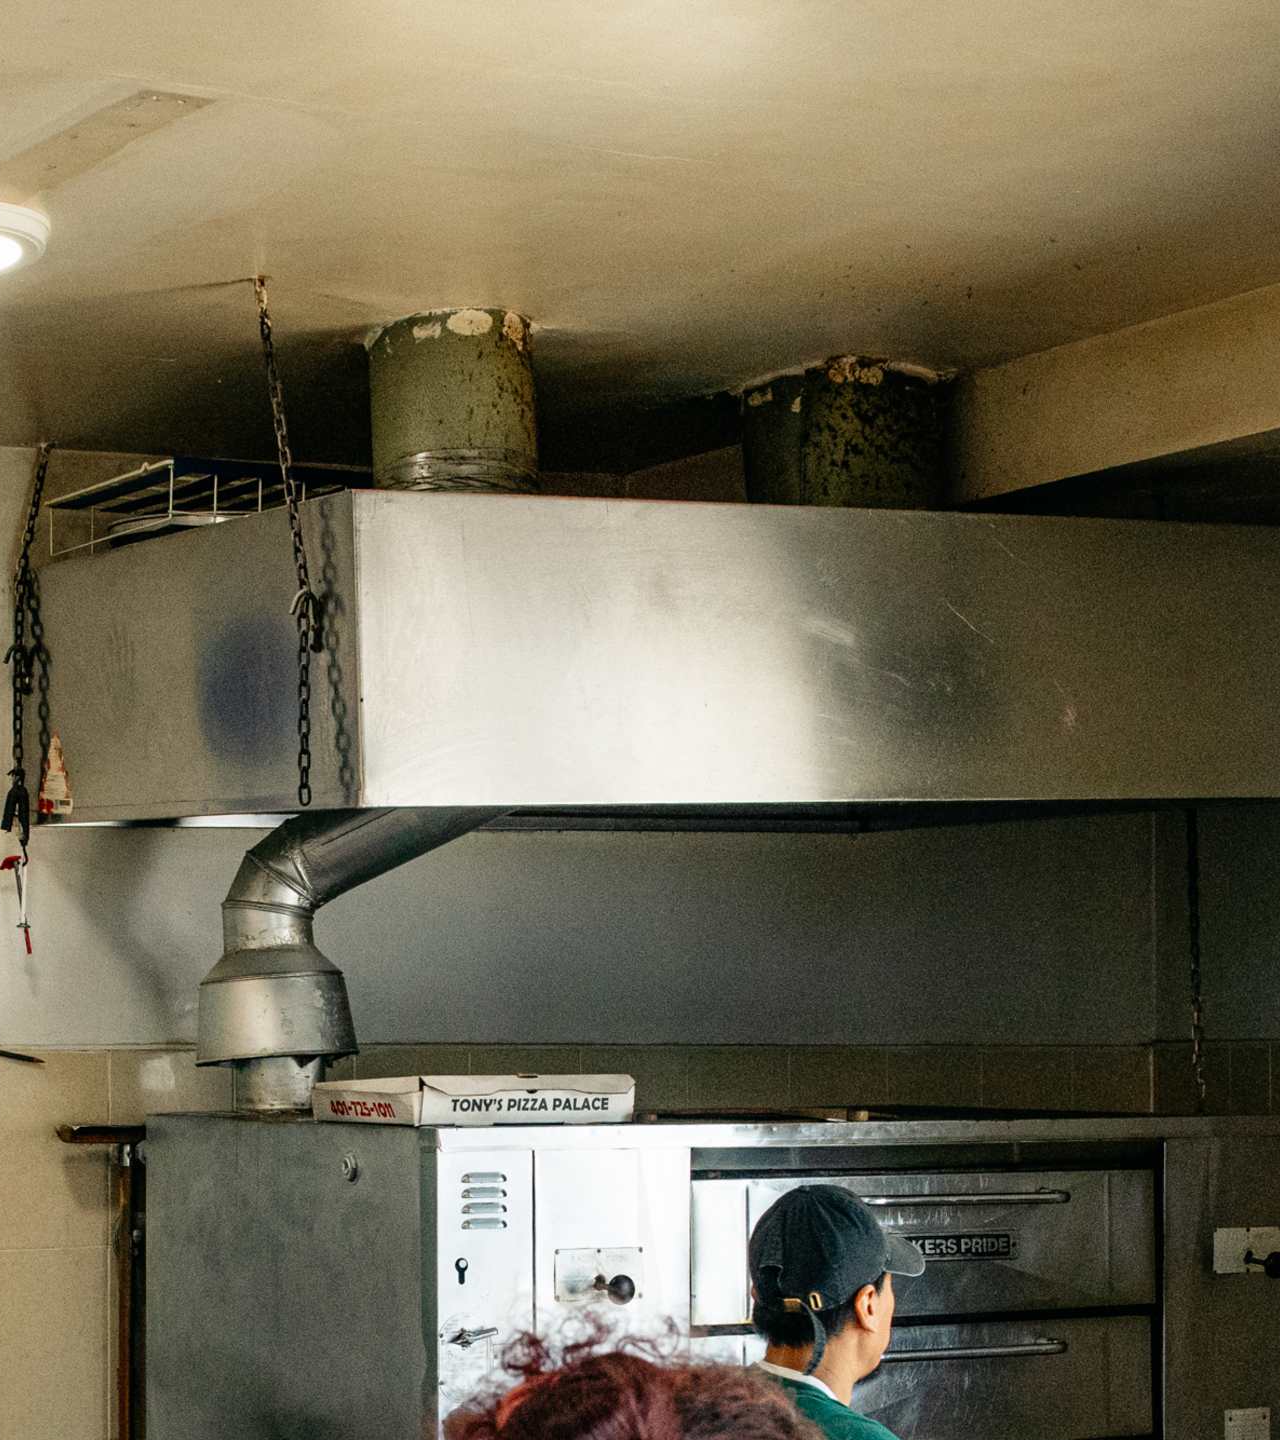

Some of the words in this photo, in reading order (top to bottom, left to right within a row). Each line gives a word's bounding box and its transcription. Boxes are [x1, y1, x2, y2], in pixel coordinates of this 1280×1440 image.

[451, 1099, 503, 1112] TONY'S
[507, 1098, 549, 1111] PIZZA
[552, 1097, 609, 1111] PALACE
[912, 1238, 958, 1255] KERS
[960, 1237, 1009, 1254] PRIDE
